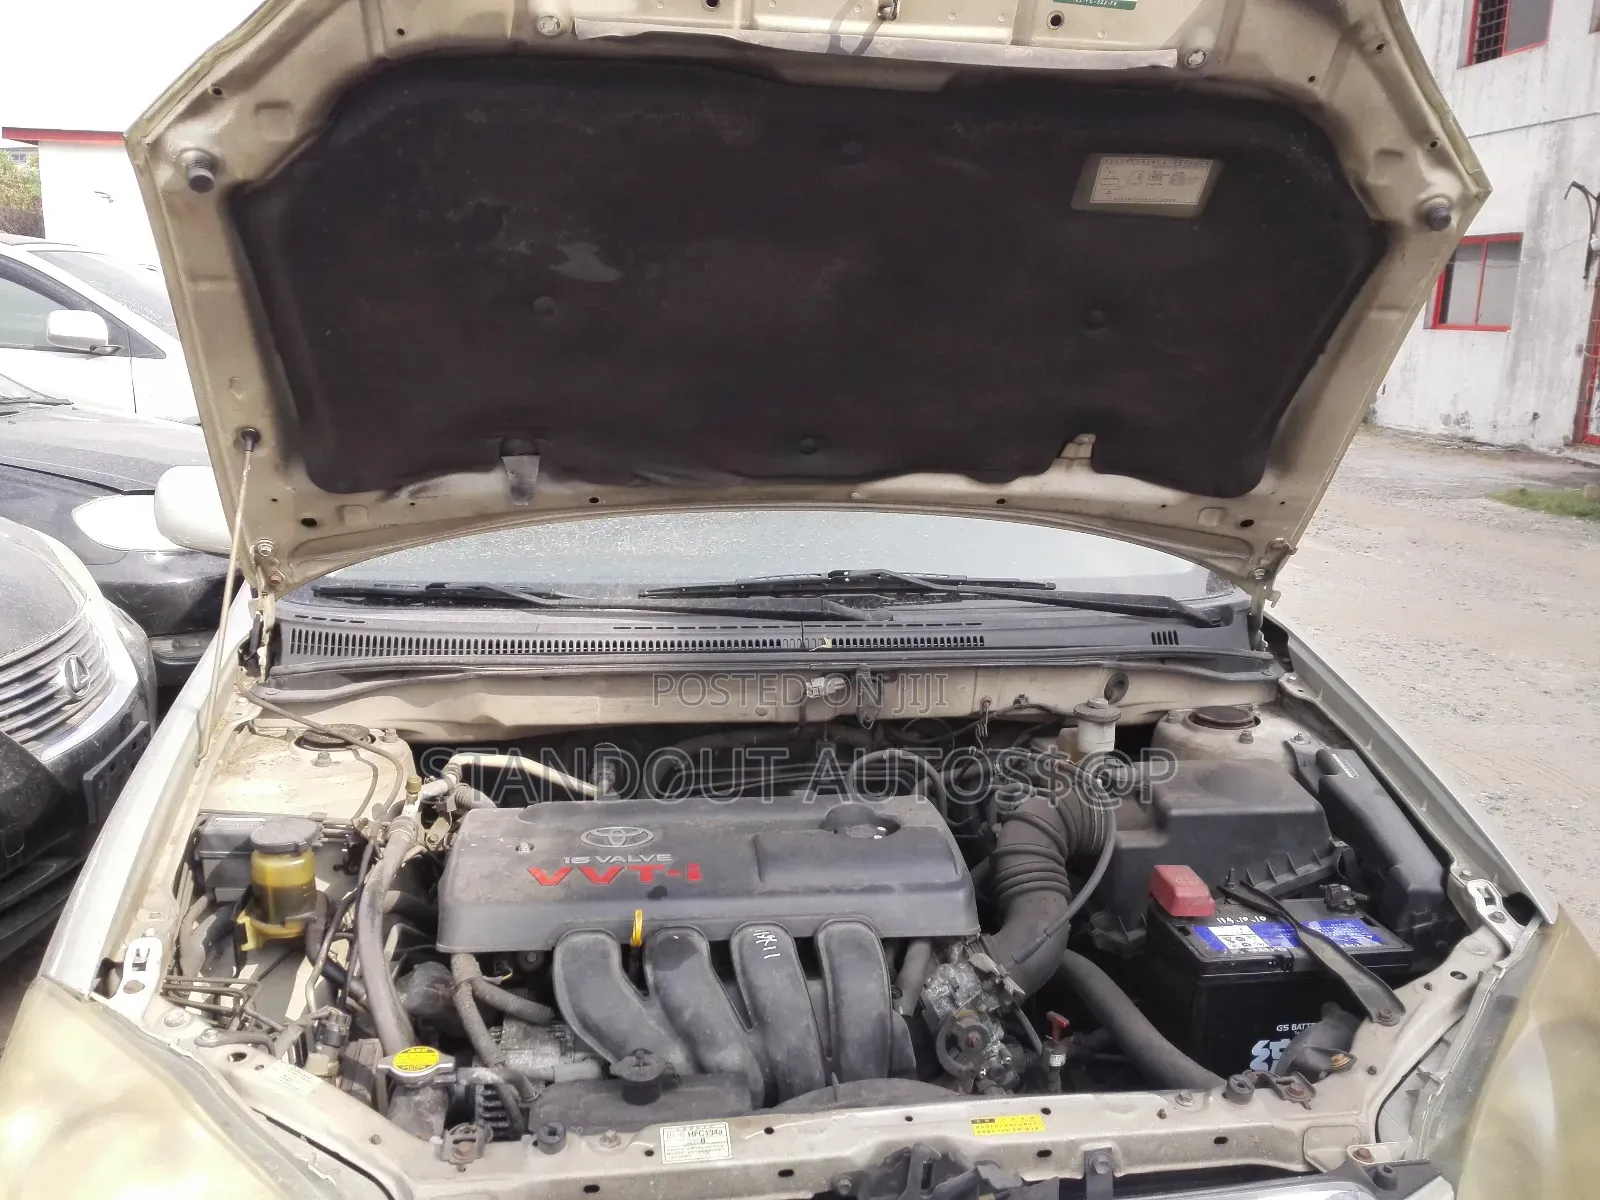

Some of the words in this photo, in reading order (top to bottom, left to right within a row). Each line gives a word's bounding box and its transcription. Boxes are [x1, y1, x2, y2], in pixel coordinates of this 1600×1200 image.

[563, 855, 591, 864] 16
[594, 853, 672, 864] VALVE
[527, 863, 702, 886] VVT-i
[1276, 1024, 1290, 1032] GS
